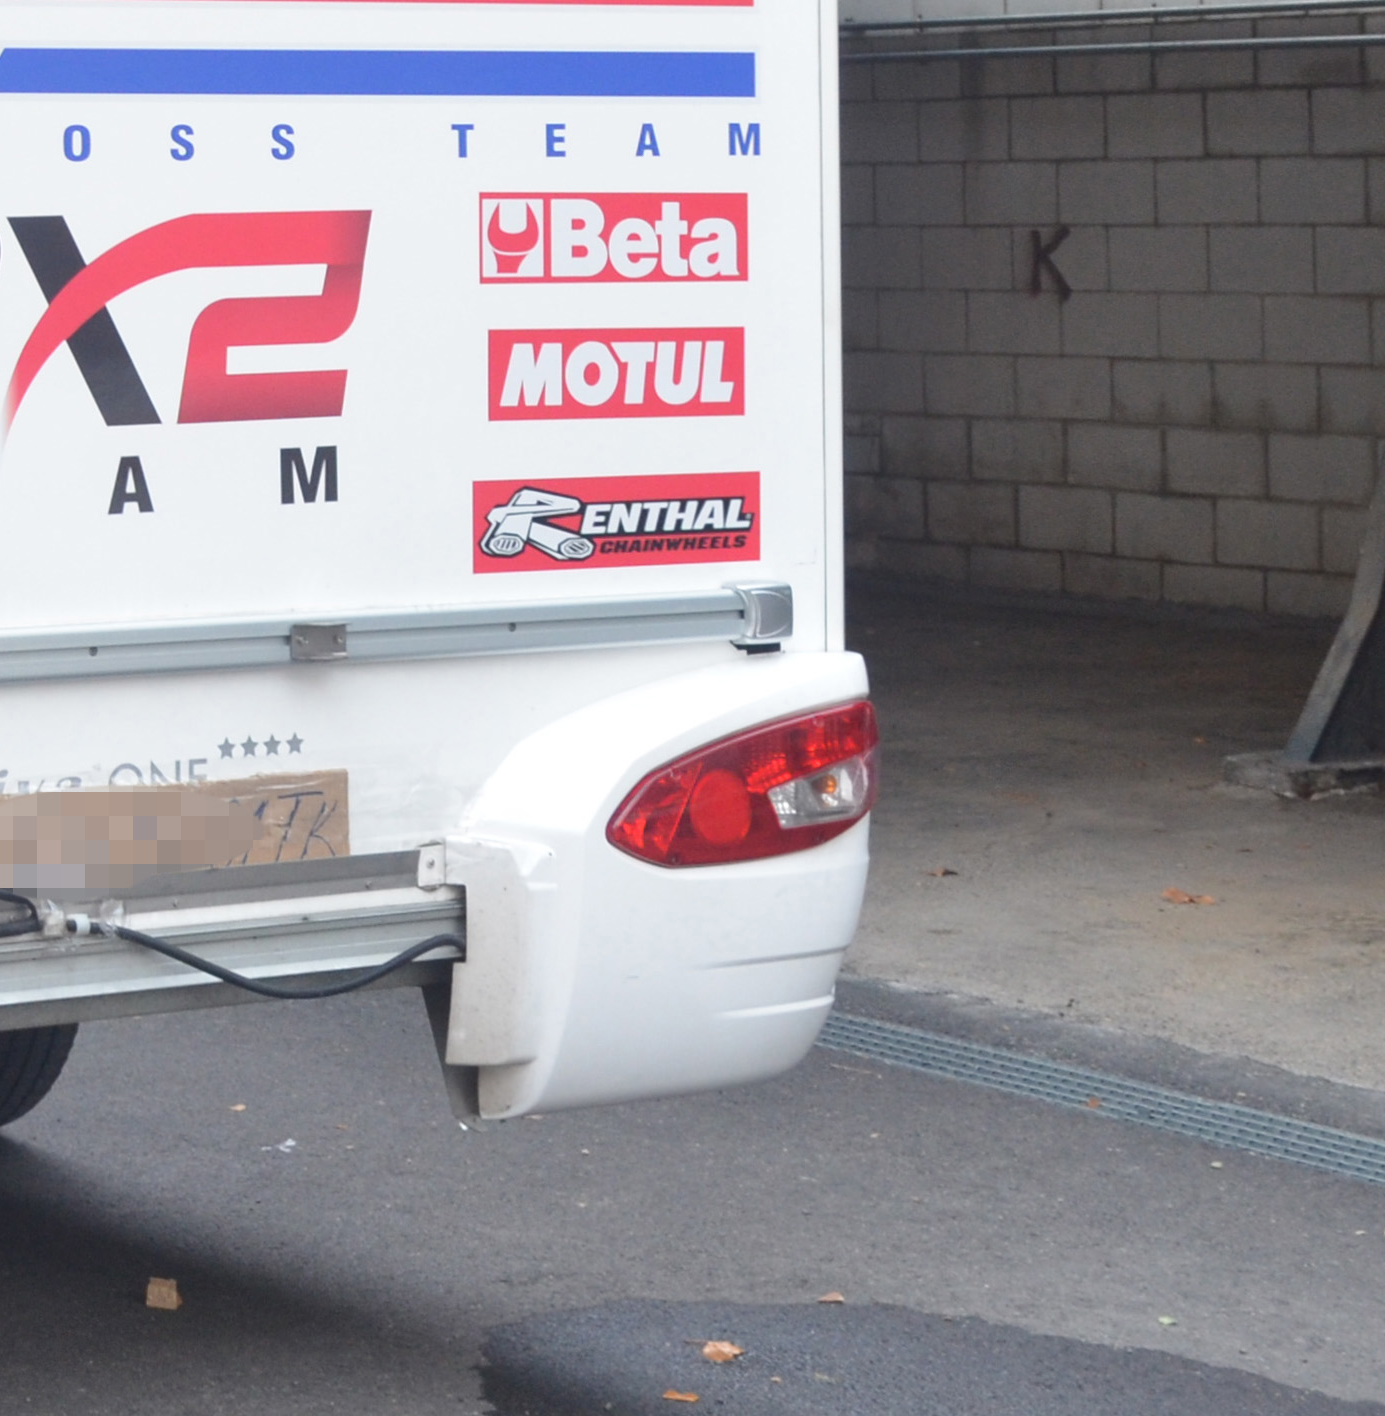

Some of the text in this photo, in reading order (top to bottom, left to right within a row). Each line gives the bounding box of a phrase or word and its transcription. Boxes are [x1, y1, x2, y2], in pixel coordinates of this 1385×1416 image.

[549, 197, 741, 279] Beta
[1029, 225, 1072, 302] K
[498, 339, 735, 407] MOTUL
[478, 484, 755, 562] RENTHAL
[599, 534, 747, 555] CHAINWHEELS
